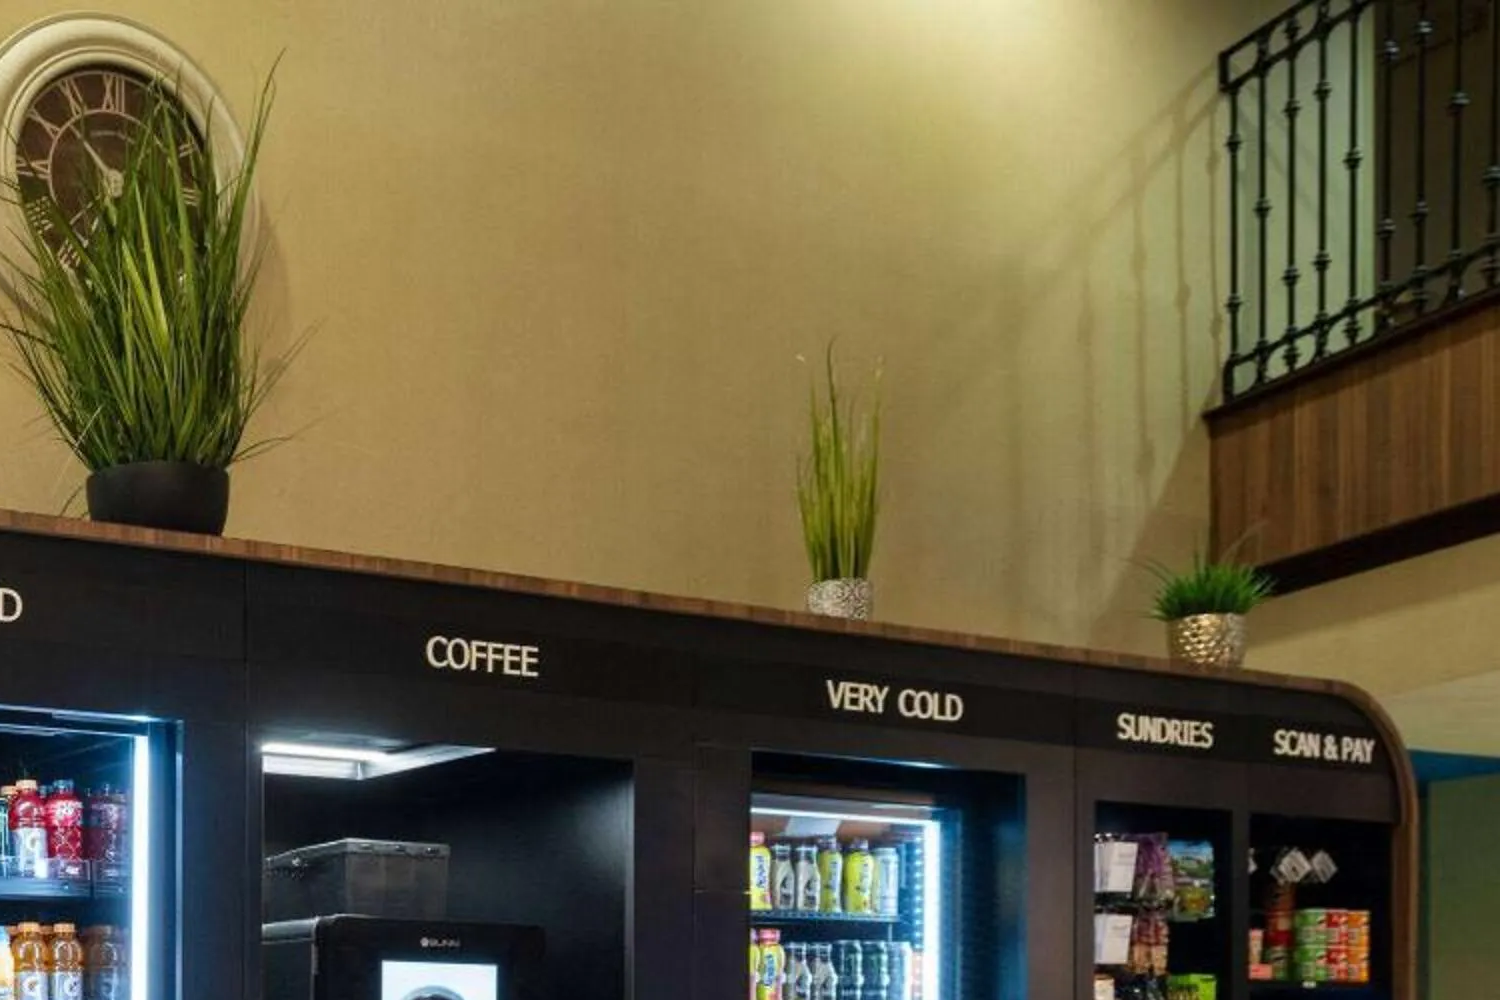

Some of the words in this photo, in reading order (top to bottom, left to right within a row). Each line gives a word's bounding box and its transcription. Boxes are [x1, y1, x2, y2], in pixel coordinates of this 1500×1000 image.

[426, 635, 540, 678] COFFEE
[827, 679, 889, 713] VERY
[898, 688, 963, 721] COLD
[1117, 712, 1213, 749] SUNDRIES
[1274, 729, 1321, 758] SCAN
[1323, 735, 1339, 761] &
[1341, 736, 1375, 763] PAY
